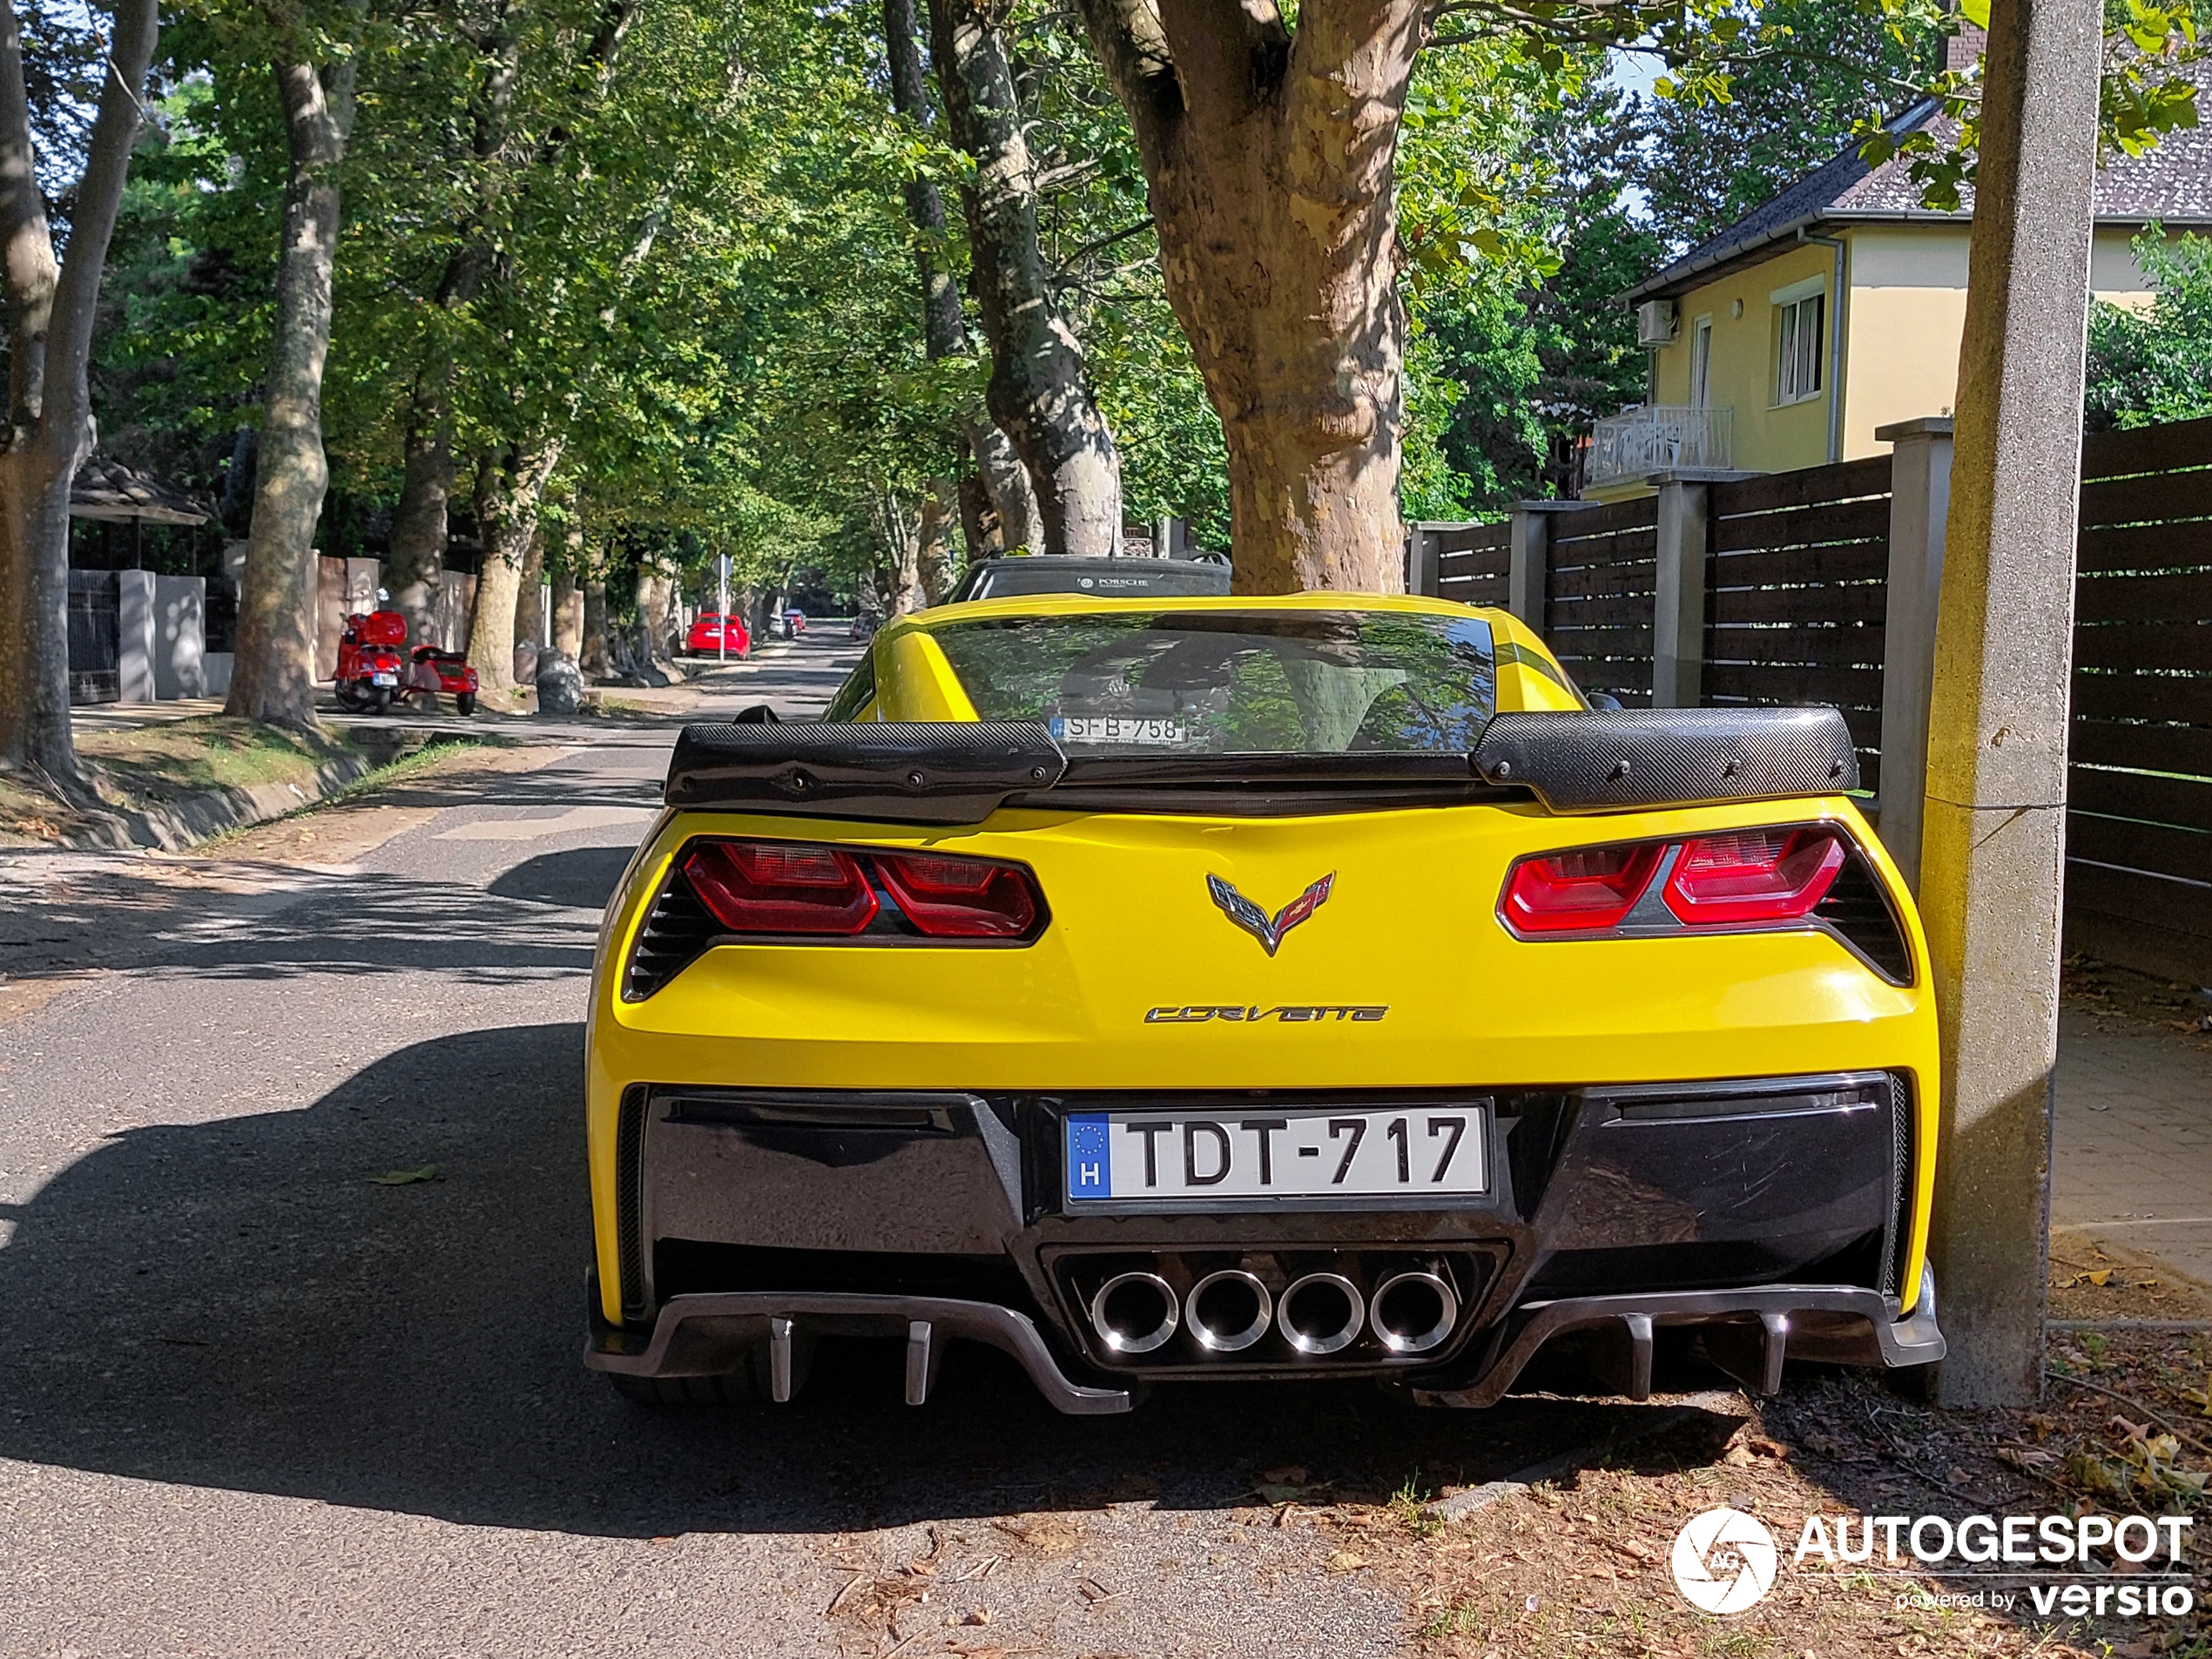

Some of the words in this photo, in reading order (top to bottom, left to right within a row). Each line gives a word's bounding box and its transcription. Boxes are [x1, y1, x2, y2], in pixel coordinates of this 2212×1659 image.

[1098, 578, 1149, 587] PORSCHE
[1069, 718, 1177, 738] SFB-758
[1143, 1005, 1392, 1023] CORVETTE
[1080, 1162, 1100, 1186] H
[1126, 1116, 1467, 1188] TDT-717
